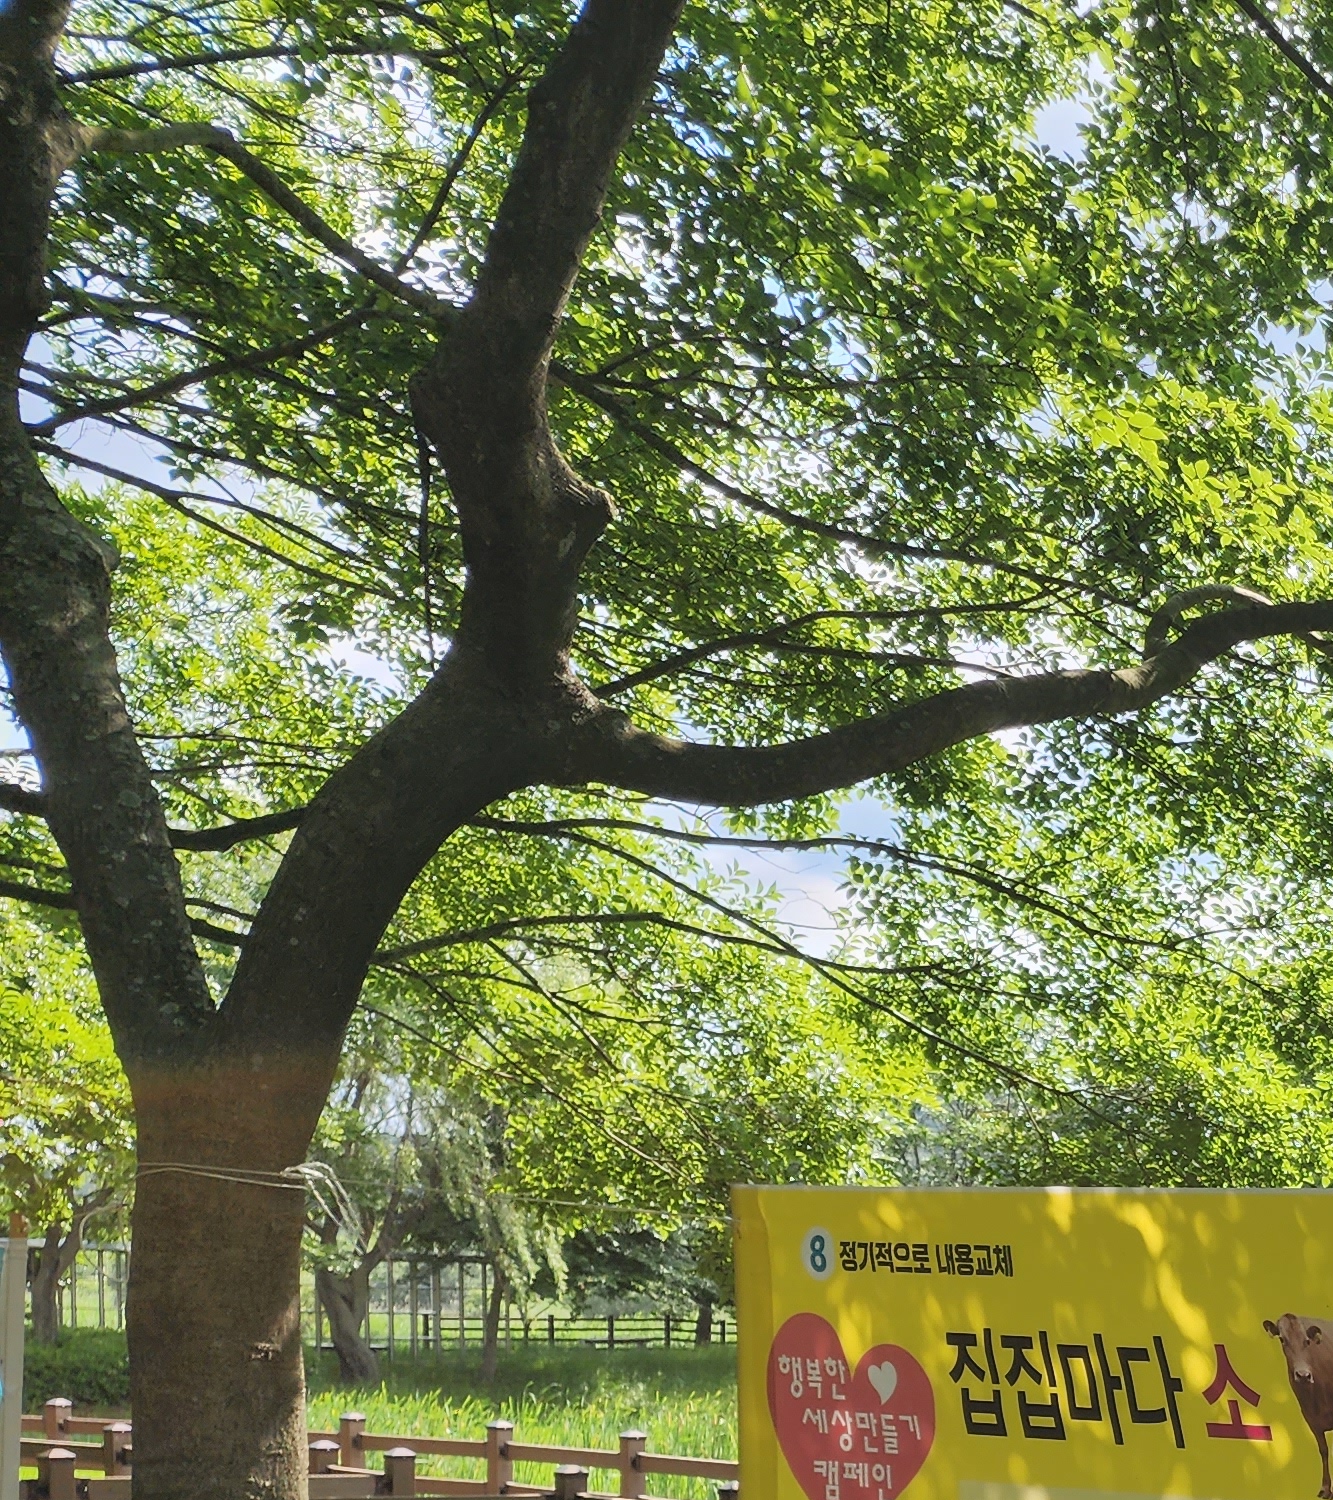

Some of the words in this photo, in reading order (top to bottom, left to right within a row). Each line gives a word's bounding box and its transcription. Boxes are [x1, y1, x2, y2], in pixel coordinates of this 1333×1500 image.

[808, 1234, 828, 1273] 8
[838, 1240, 932, 1275] 정기적으로
[935, 1242, 1014, 1278] 내용교체
[778, 1353, 848, 1401] 행복한
[945, 1327, 1187, 1450] 집집마다
[1202, 1343, 1274, 1442] 소
[802, 1408, 922, 1456] 세상만들기
